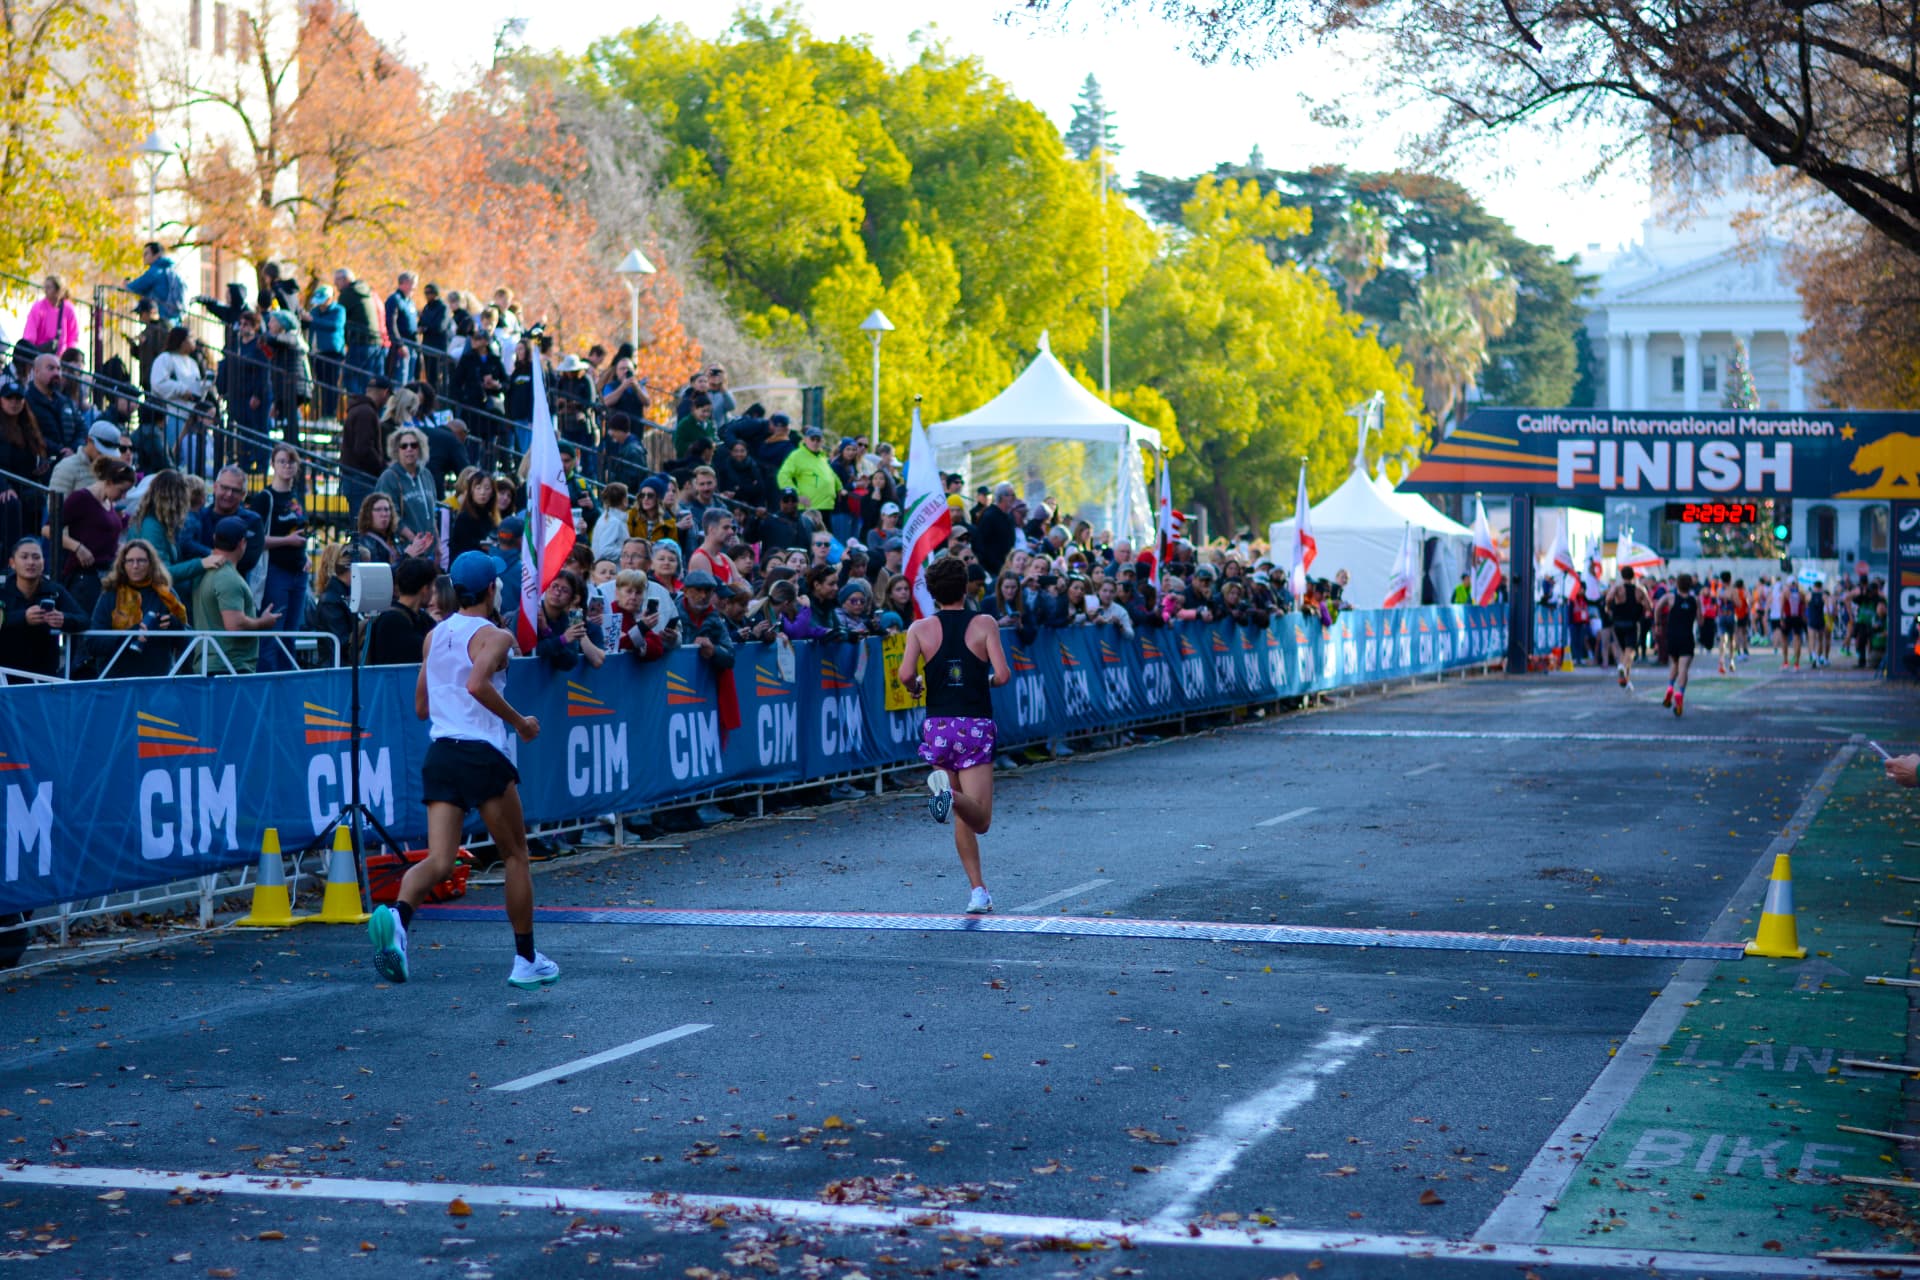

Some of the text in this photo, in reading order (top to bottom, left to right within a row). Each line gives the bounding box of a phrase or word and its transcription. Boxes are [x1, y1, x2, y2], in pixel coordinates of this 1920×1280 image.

[1517, 414, 1834, 436] California International Marathon
[1557, 440, 1792, 491] FINISH
[821, 694, 863, 757] CIM
[1016, 673, 1047, 728] CIM
[567, 722, 629, 798] CIM
[668, 708, 723, 781] CIM
[757, 702, 797, 768] CIM
[139, 763, 239, 861] CIM
[307, 746, 395, 837] CIM
[1624, 1128, 1857, 1184] BIKE
